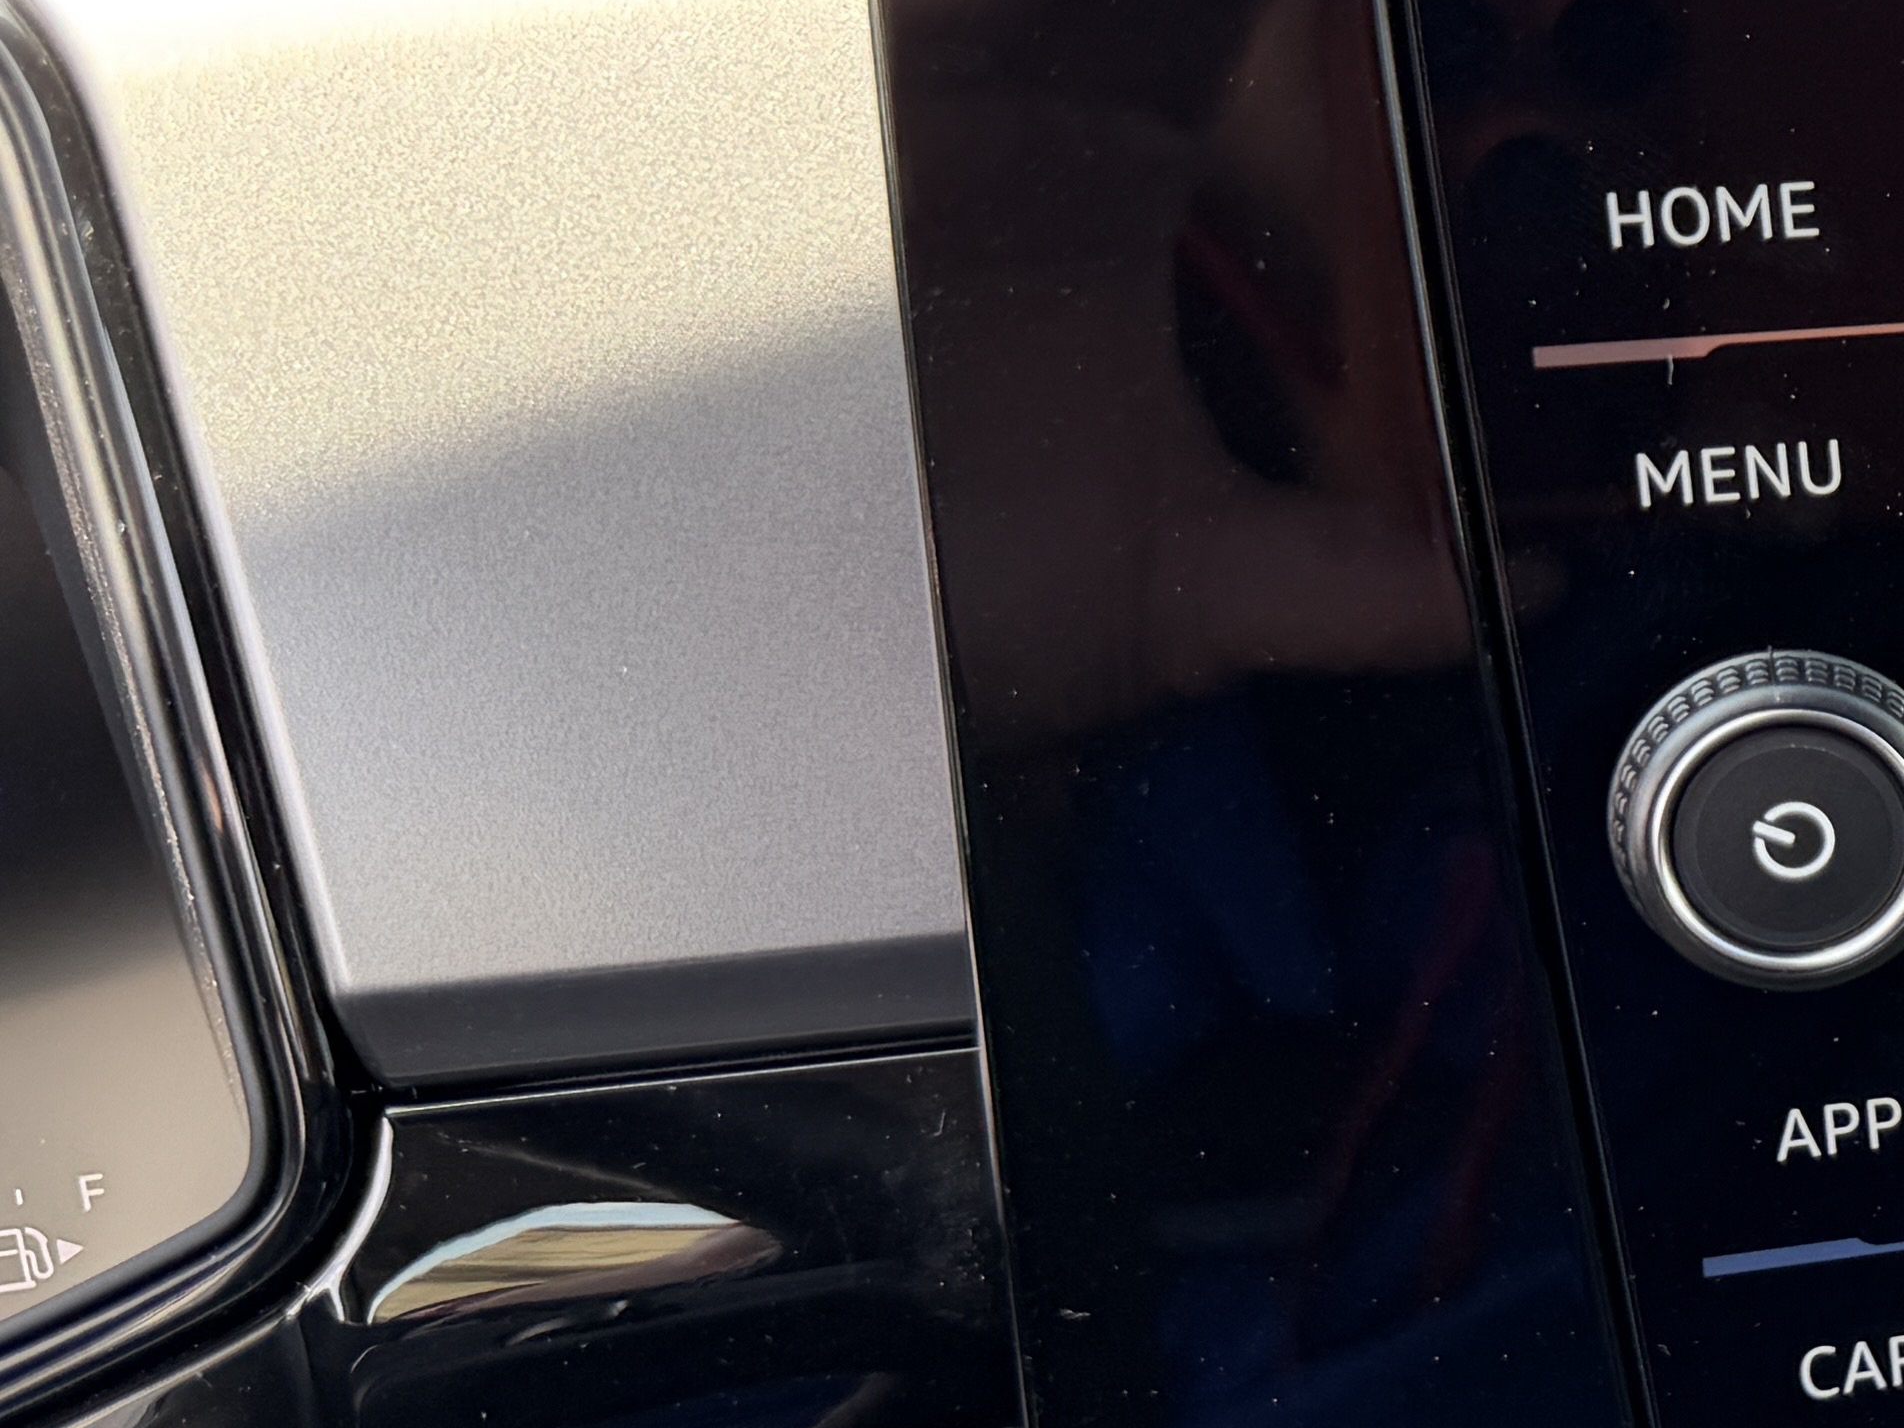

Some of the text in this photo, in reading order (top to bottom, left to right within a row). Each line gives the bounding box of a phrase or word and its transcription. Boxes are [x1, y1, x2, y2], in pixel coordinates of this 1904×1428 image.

[1605, 179, 1821, 251] HOME
[1634, 437, 1845, 510] MENU
[1775, 1094, 1904, 1164] APP
[76, 1172, 106, 1213] F
